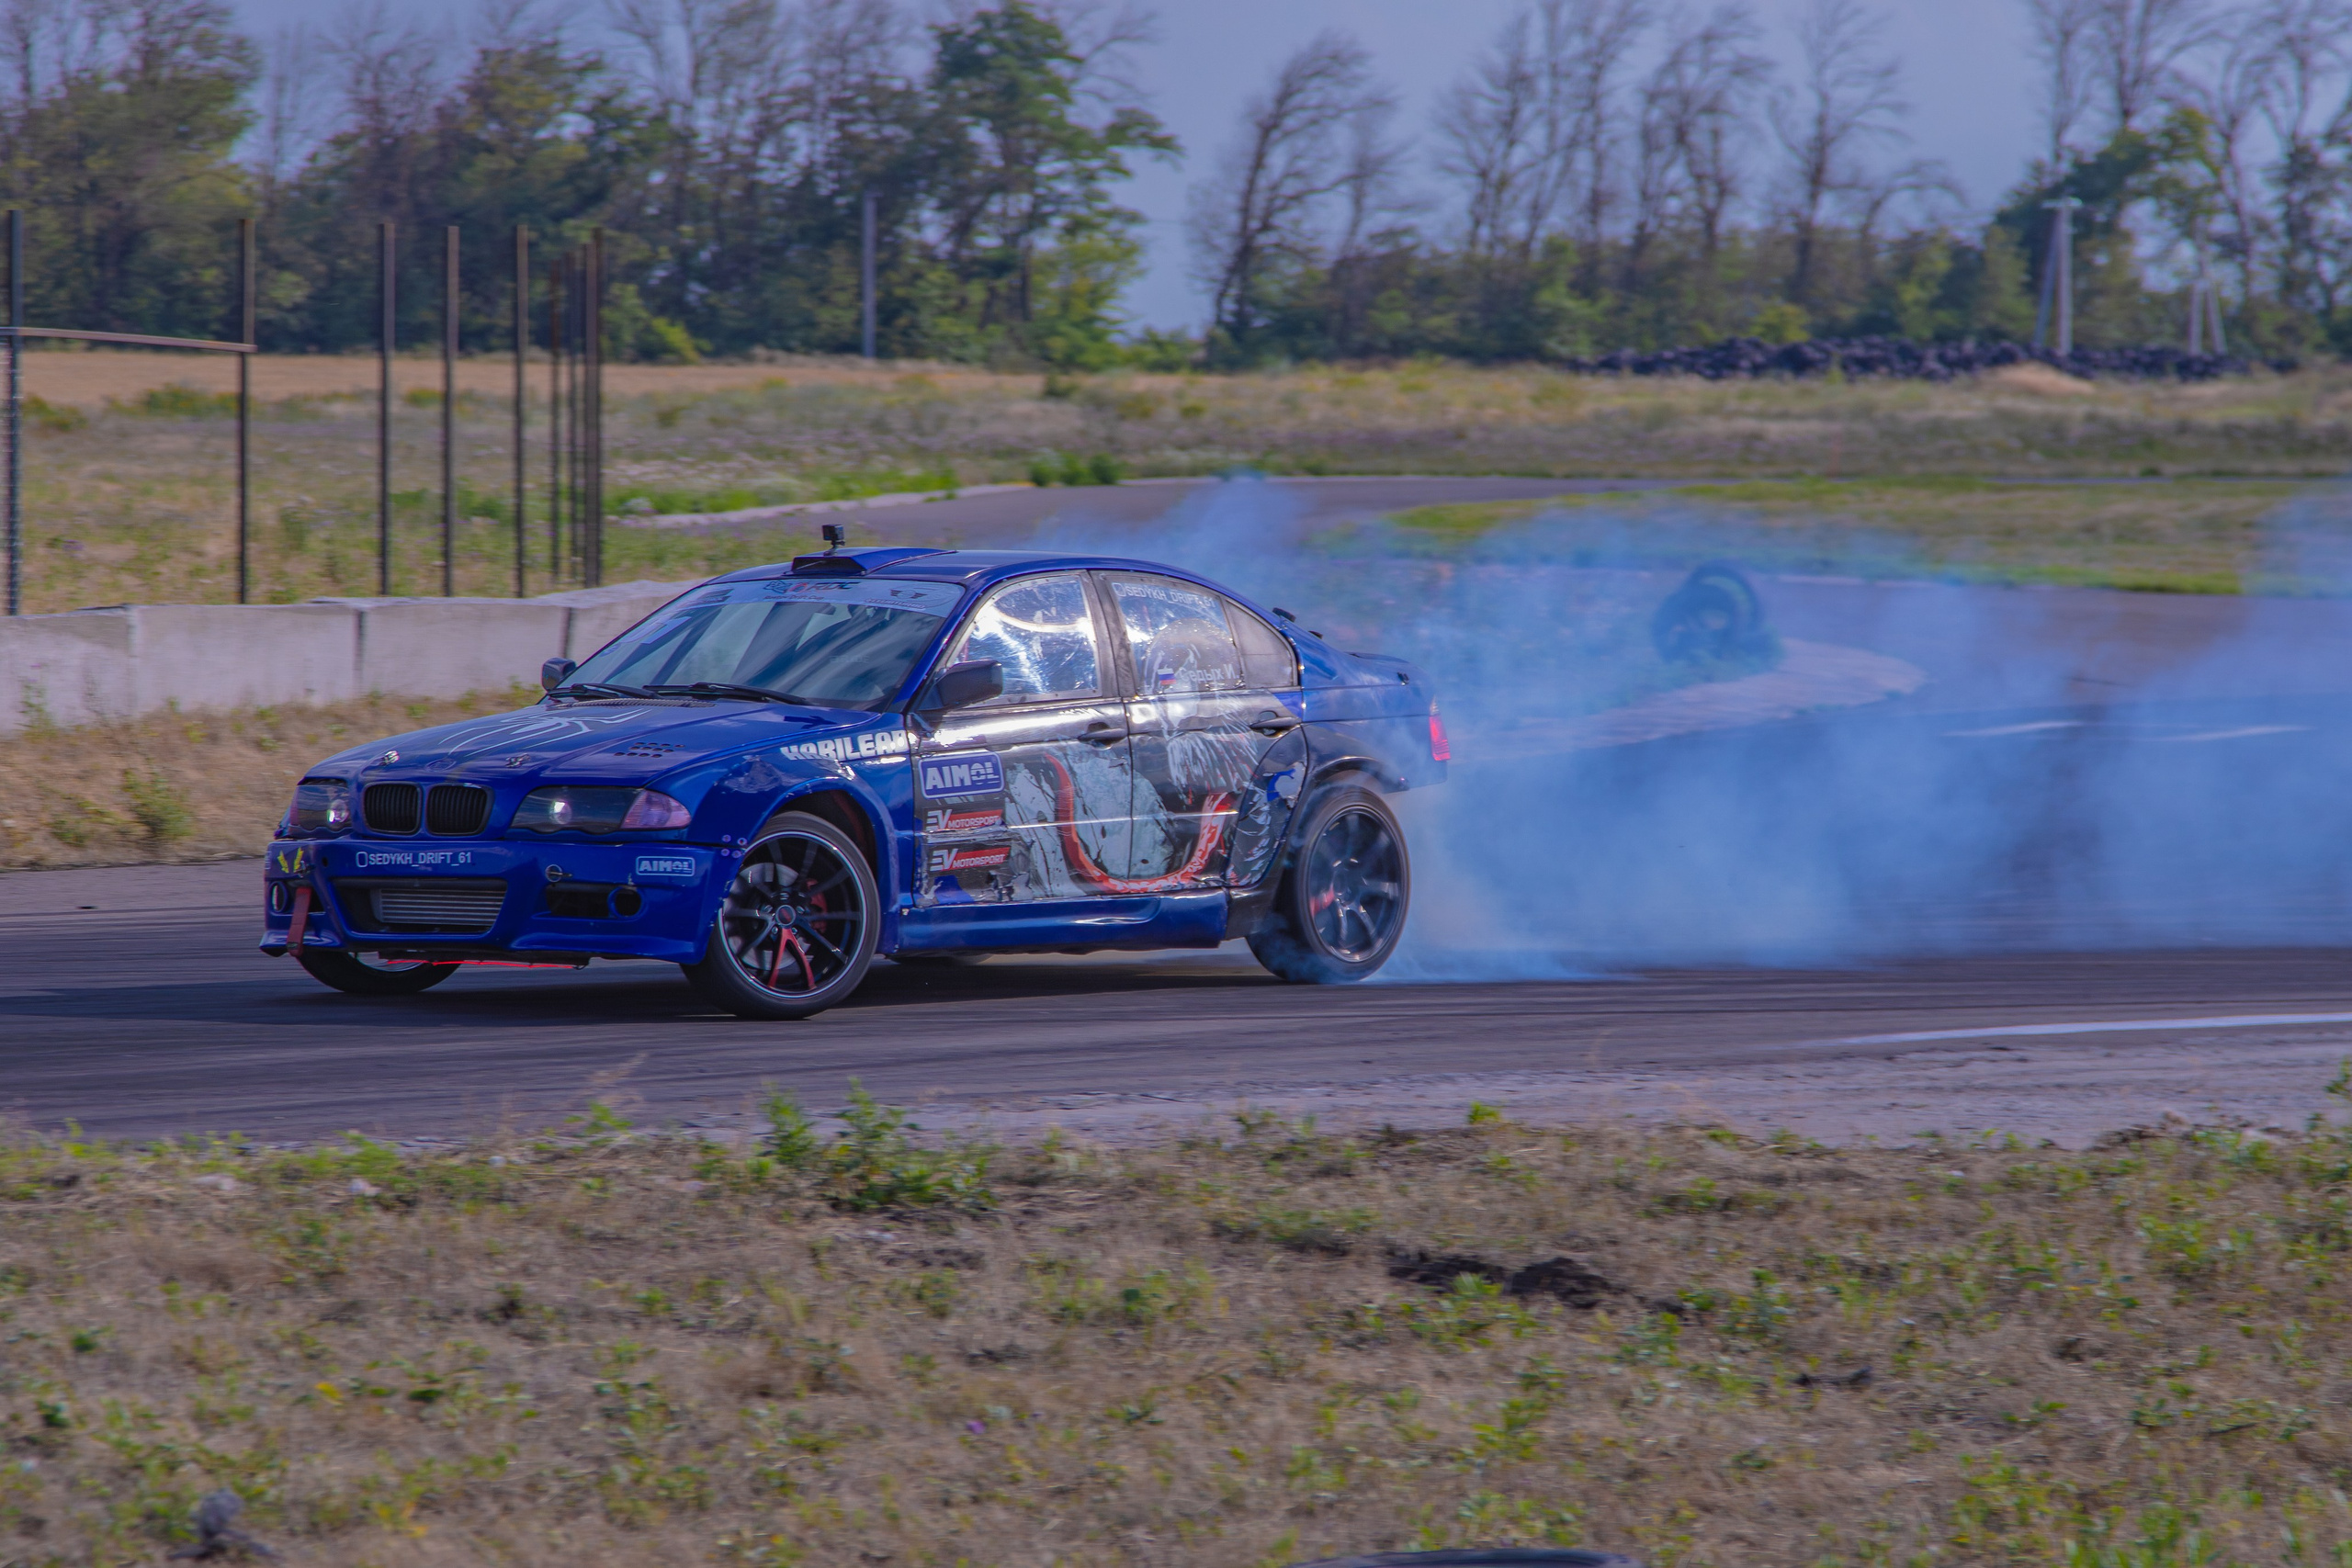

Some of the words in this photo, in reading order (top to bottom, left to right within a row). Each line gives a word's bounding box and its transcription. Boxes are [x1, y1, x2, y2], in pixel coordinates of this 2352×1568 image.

[925, 761, 1001, 790] AIMOL
[947, 815, 1000, 829] MOTORSPORT
[368, 852, 472, 867] SEDYKH_DRIFT_61
[952, 854, 1006, 868] MOTORSPORT
[639, 860, 692, 874] AIMOL
